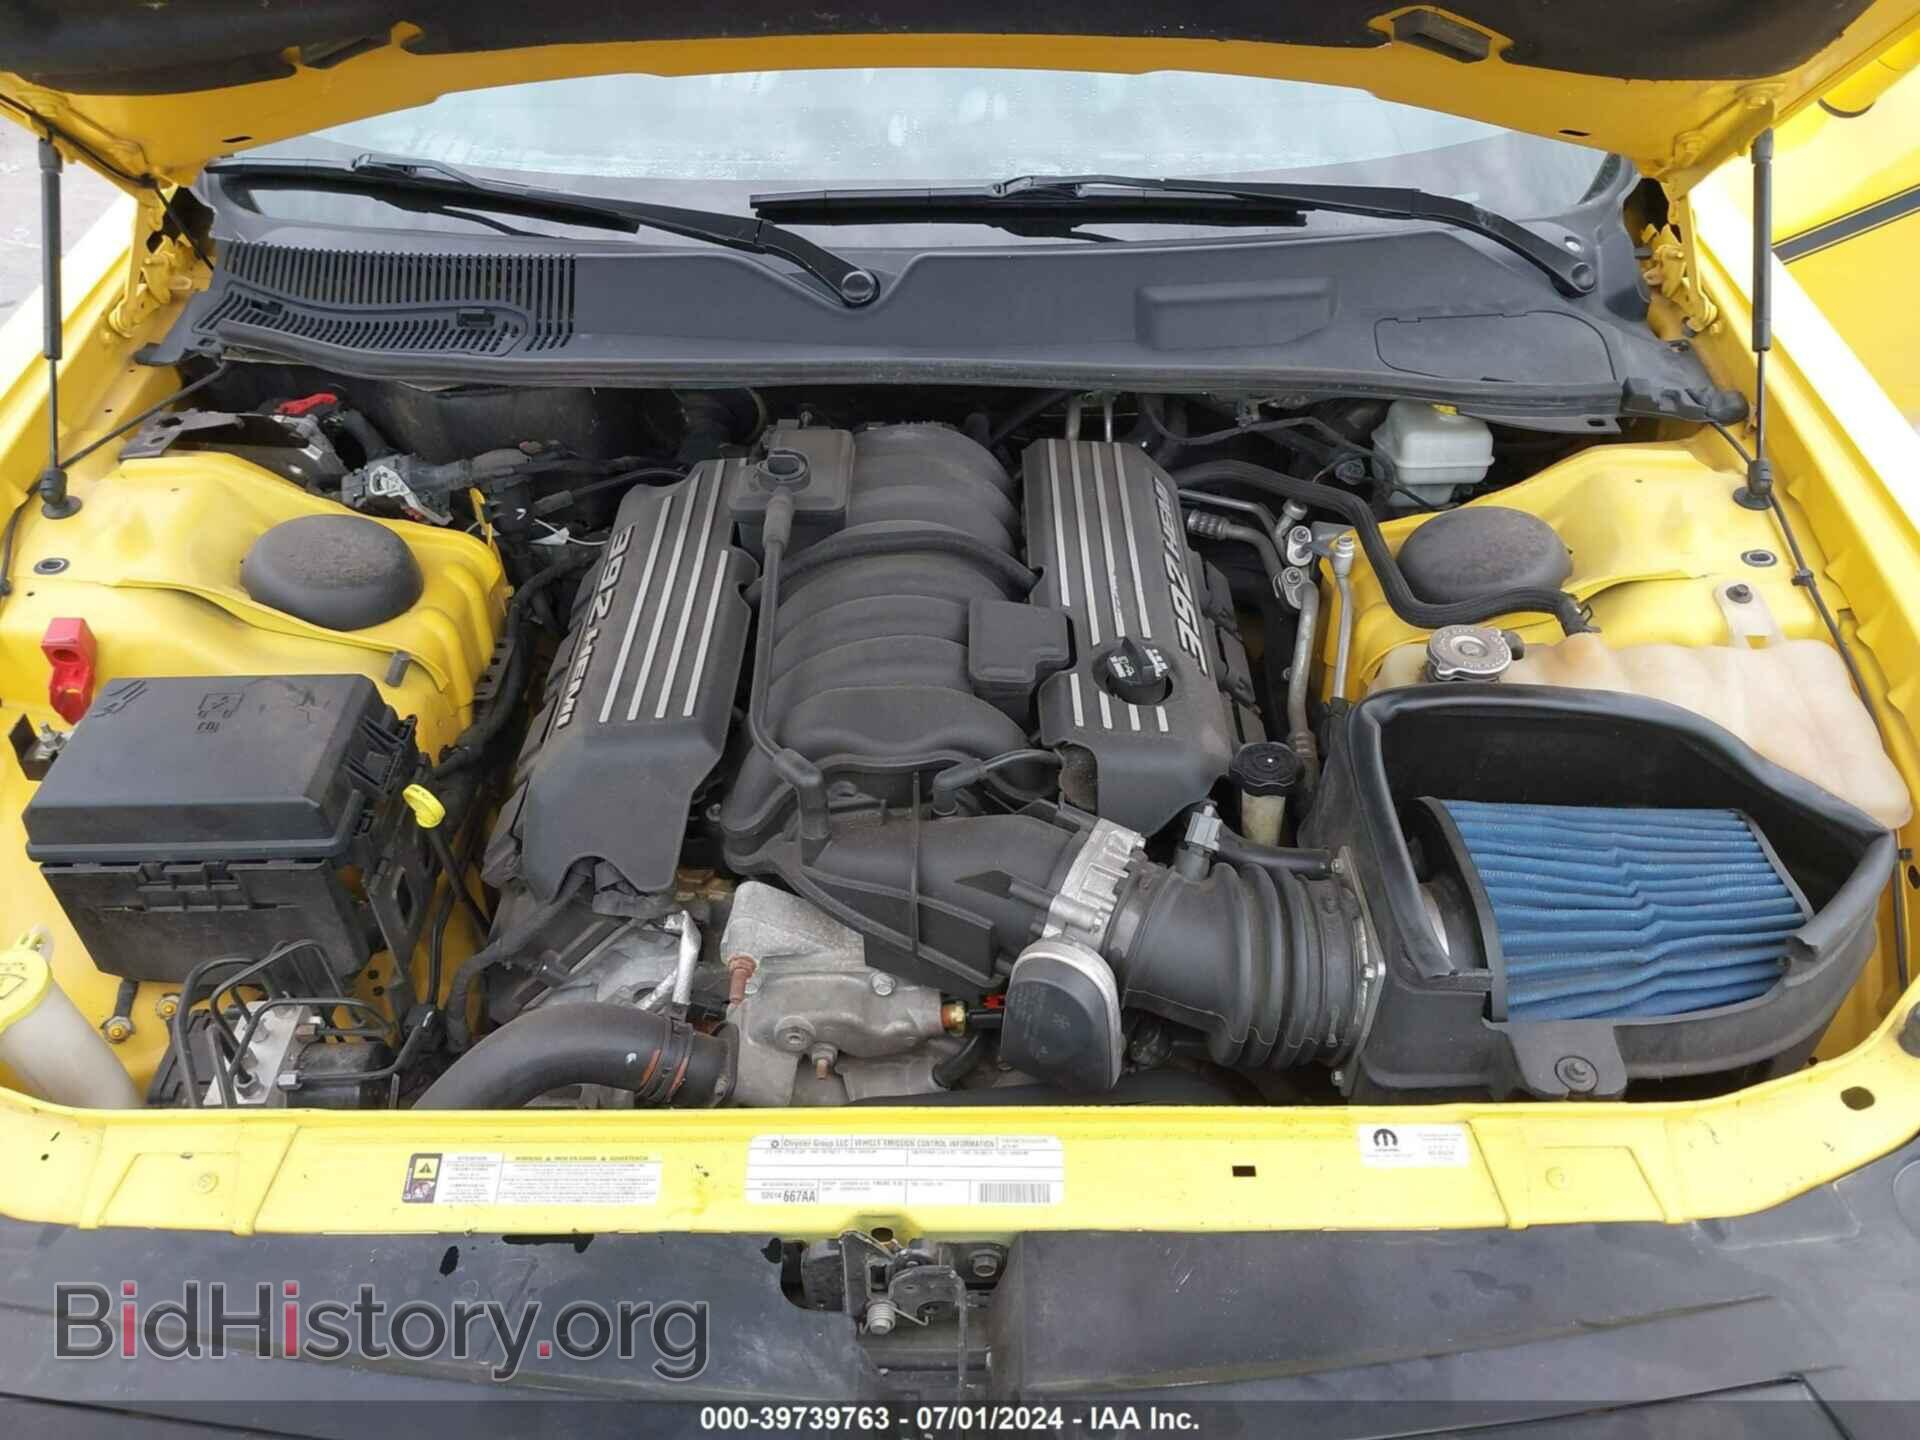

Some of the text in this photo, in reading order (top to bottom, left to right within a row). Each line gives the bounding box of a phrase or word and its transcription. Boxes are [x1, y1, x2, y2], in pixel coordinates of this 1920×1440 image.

[556, 524, 635, 730] 392 HEMI
[1164, 551, 1208, 677] 392
[813, 1138, 834, 1149] Group
[836, 1138, 849, 1148] LLC
[855, 1138, 882, 1149] VEHICLE
[883, 1138, 915, 1149] EMISSION
[917, 1138, 947, 1149] CONTROL
[950, 1138, 995, 1149] INFORMATION
[783, 1190, 816, 1203] 667AA
